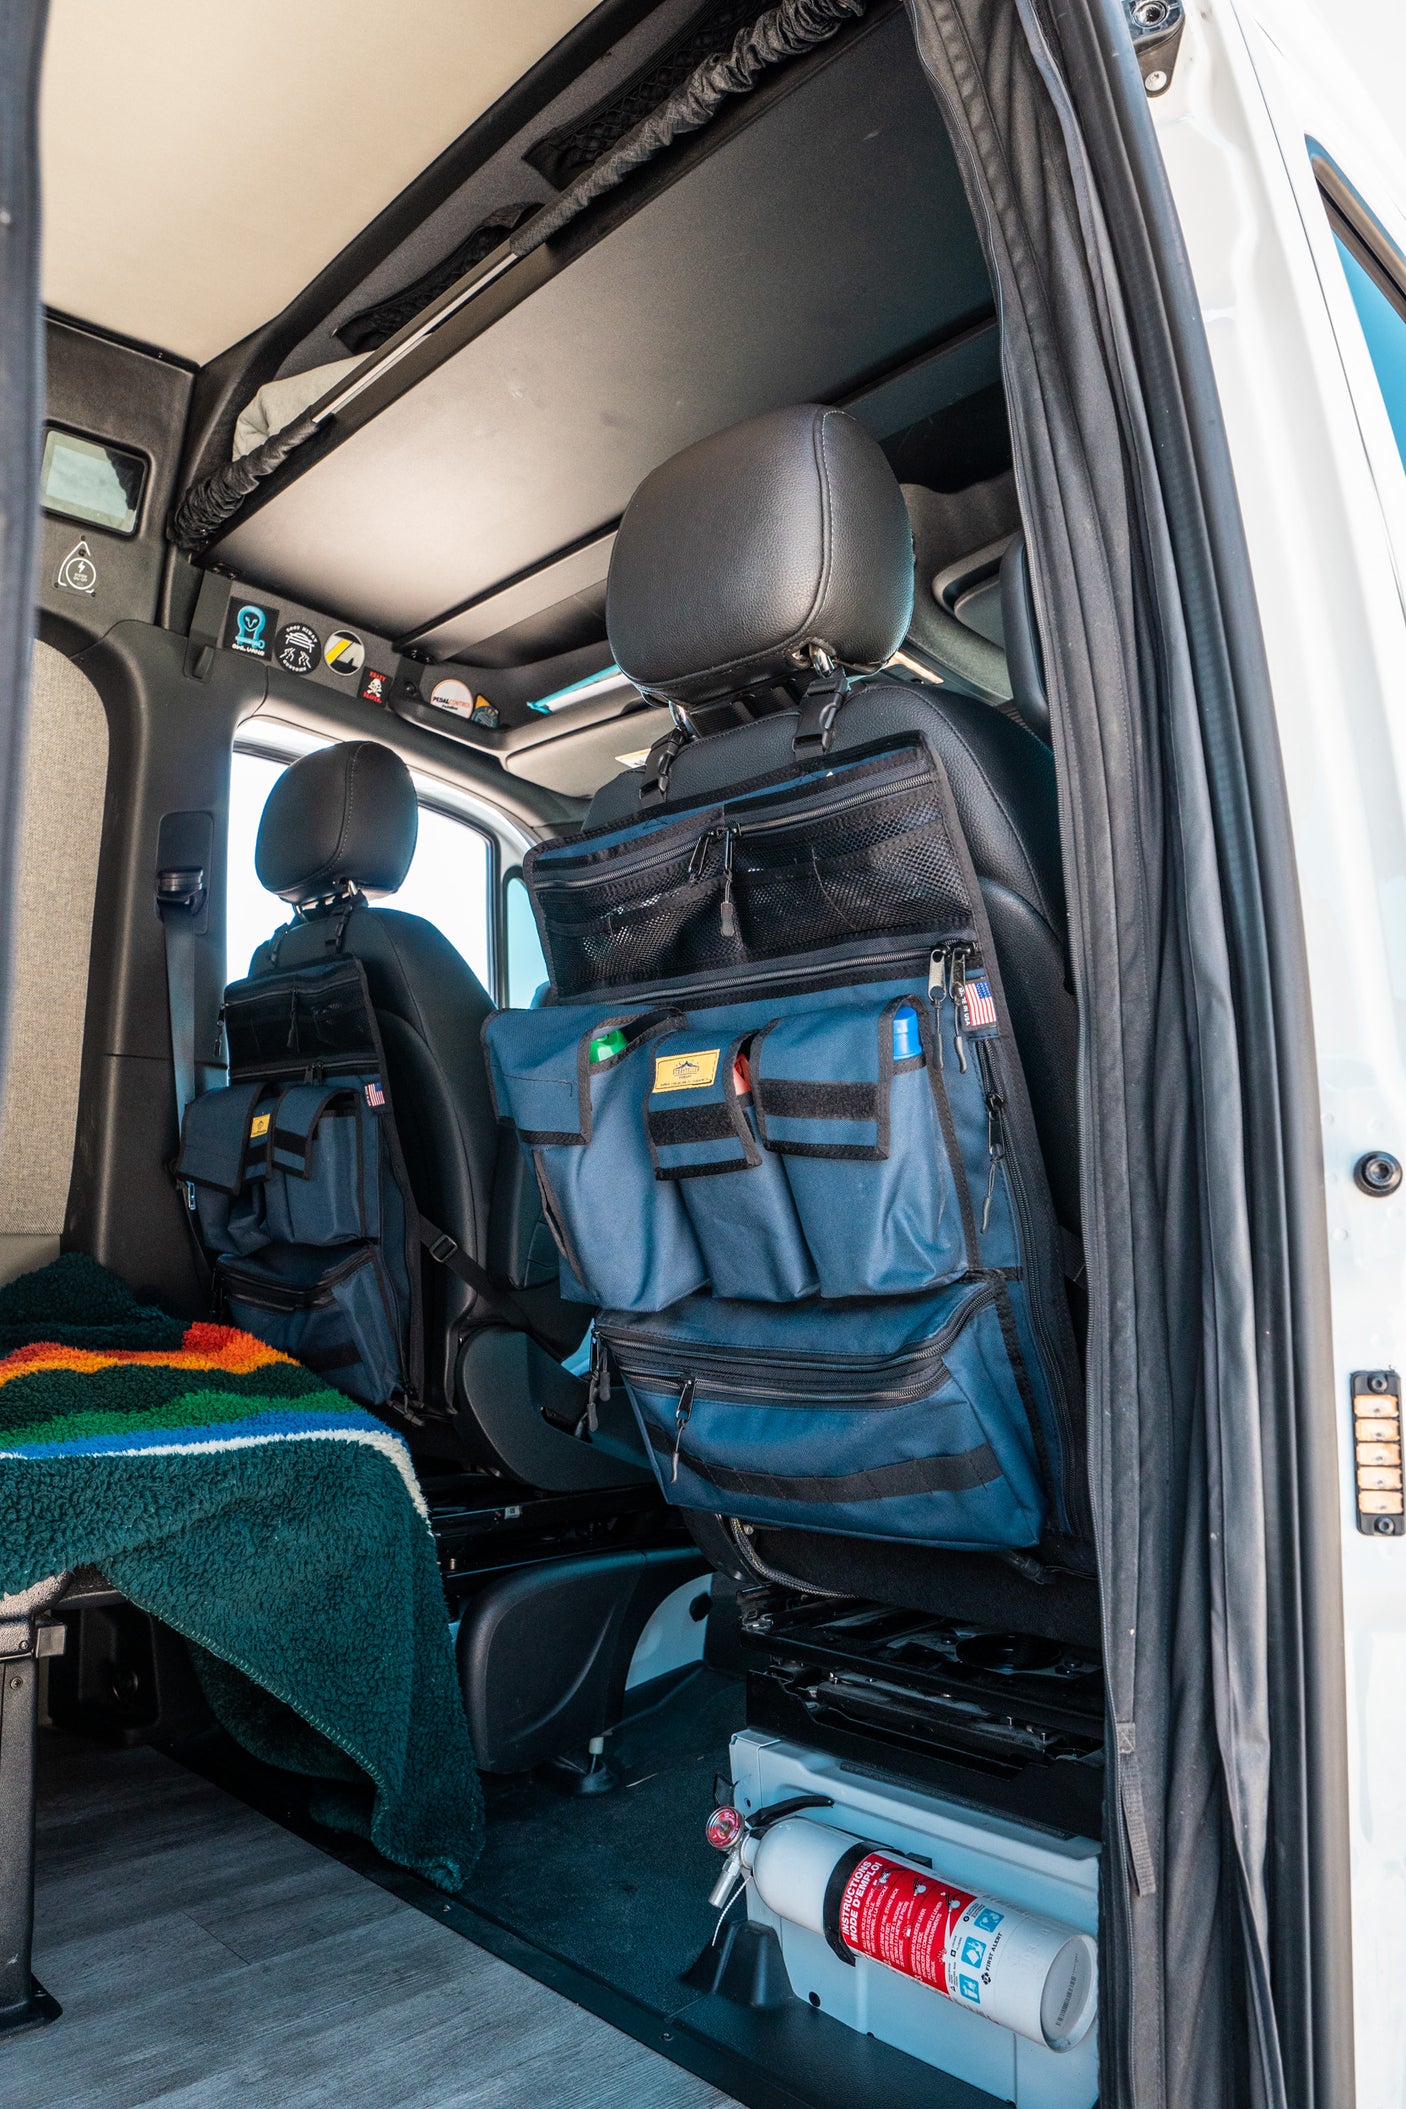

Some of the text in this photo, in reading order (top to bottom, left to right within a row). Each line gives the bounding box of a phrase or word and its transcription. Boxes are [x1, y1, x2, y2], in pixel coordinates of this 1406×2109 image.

[843, 1860, 872, 1935] INSTRUCTIONS
[851, 1862, 883, 1943] MODE D'EMPLOI
[884, 1899, 893, 1915] STAND
[912, 1922, 920, 1944] SQUEEZE
[985, 1932, 1003, 1972] FIRST ALERT
